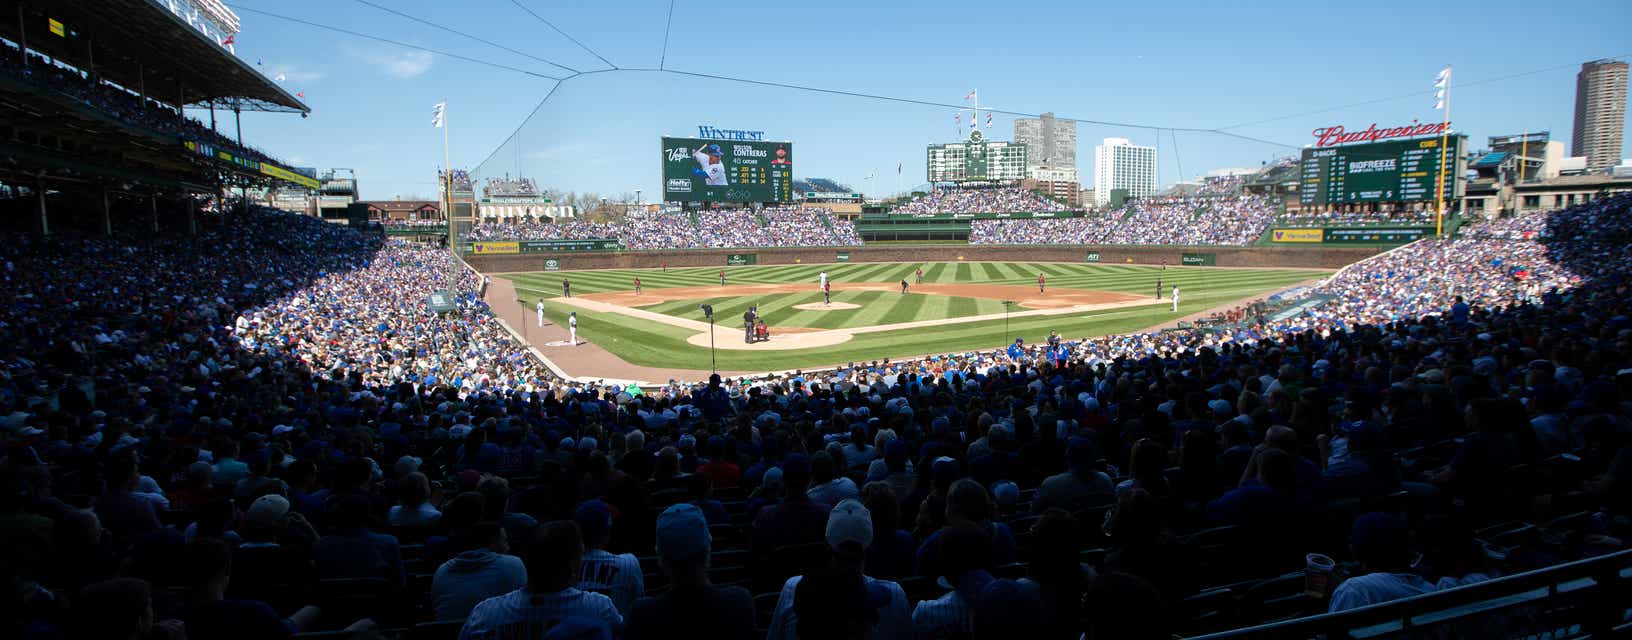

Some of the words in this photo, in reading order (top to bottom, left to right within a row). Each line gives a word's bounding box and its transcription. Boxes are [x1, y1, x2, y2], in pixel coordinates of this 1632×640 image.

[698, 126, 764, 141] WINTRUST
[1312, 119, 1451, 147] Budweiser
[734, 149, 767, 158] CONTRERAS
[1349, 159, 1397, 170] BIOFREEZE
[480, 206, 574, 218] nuveen
[580, 560, 620, 584] ANT
